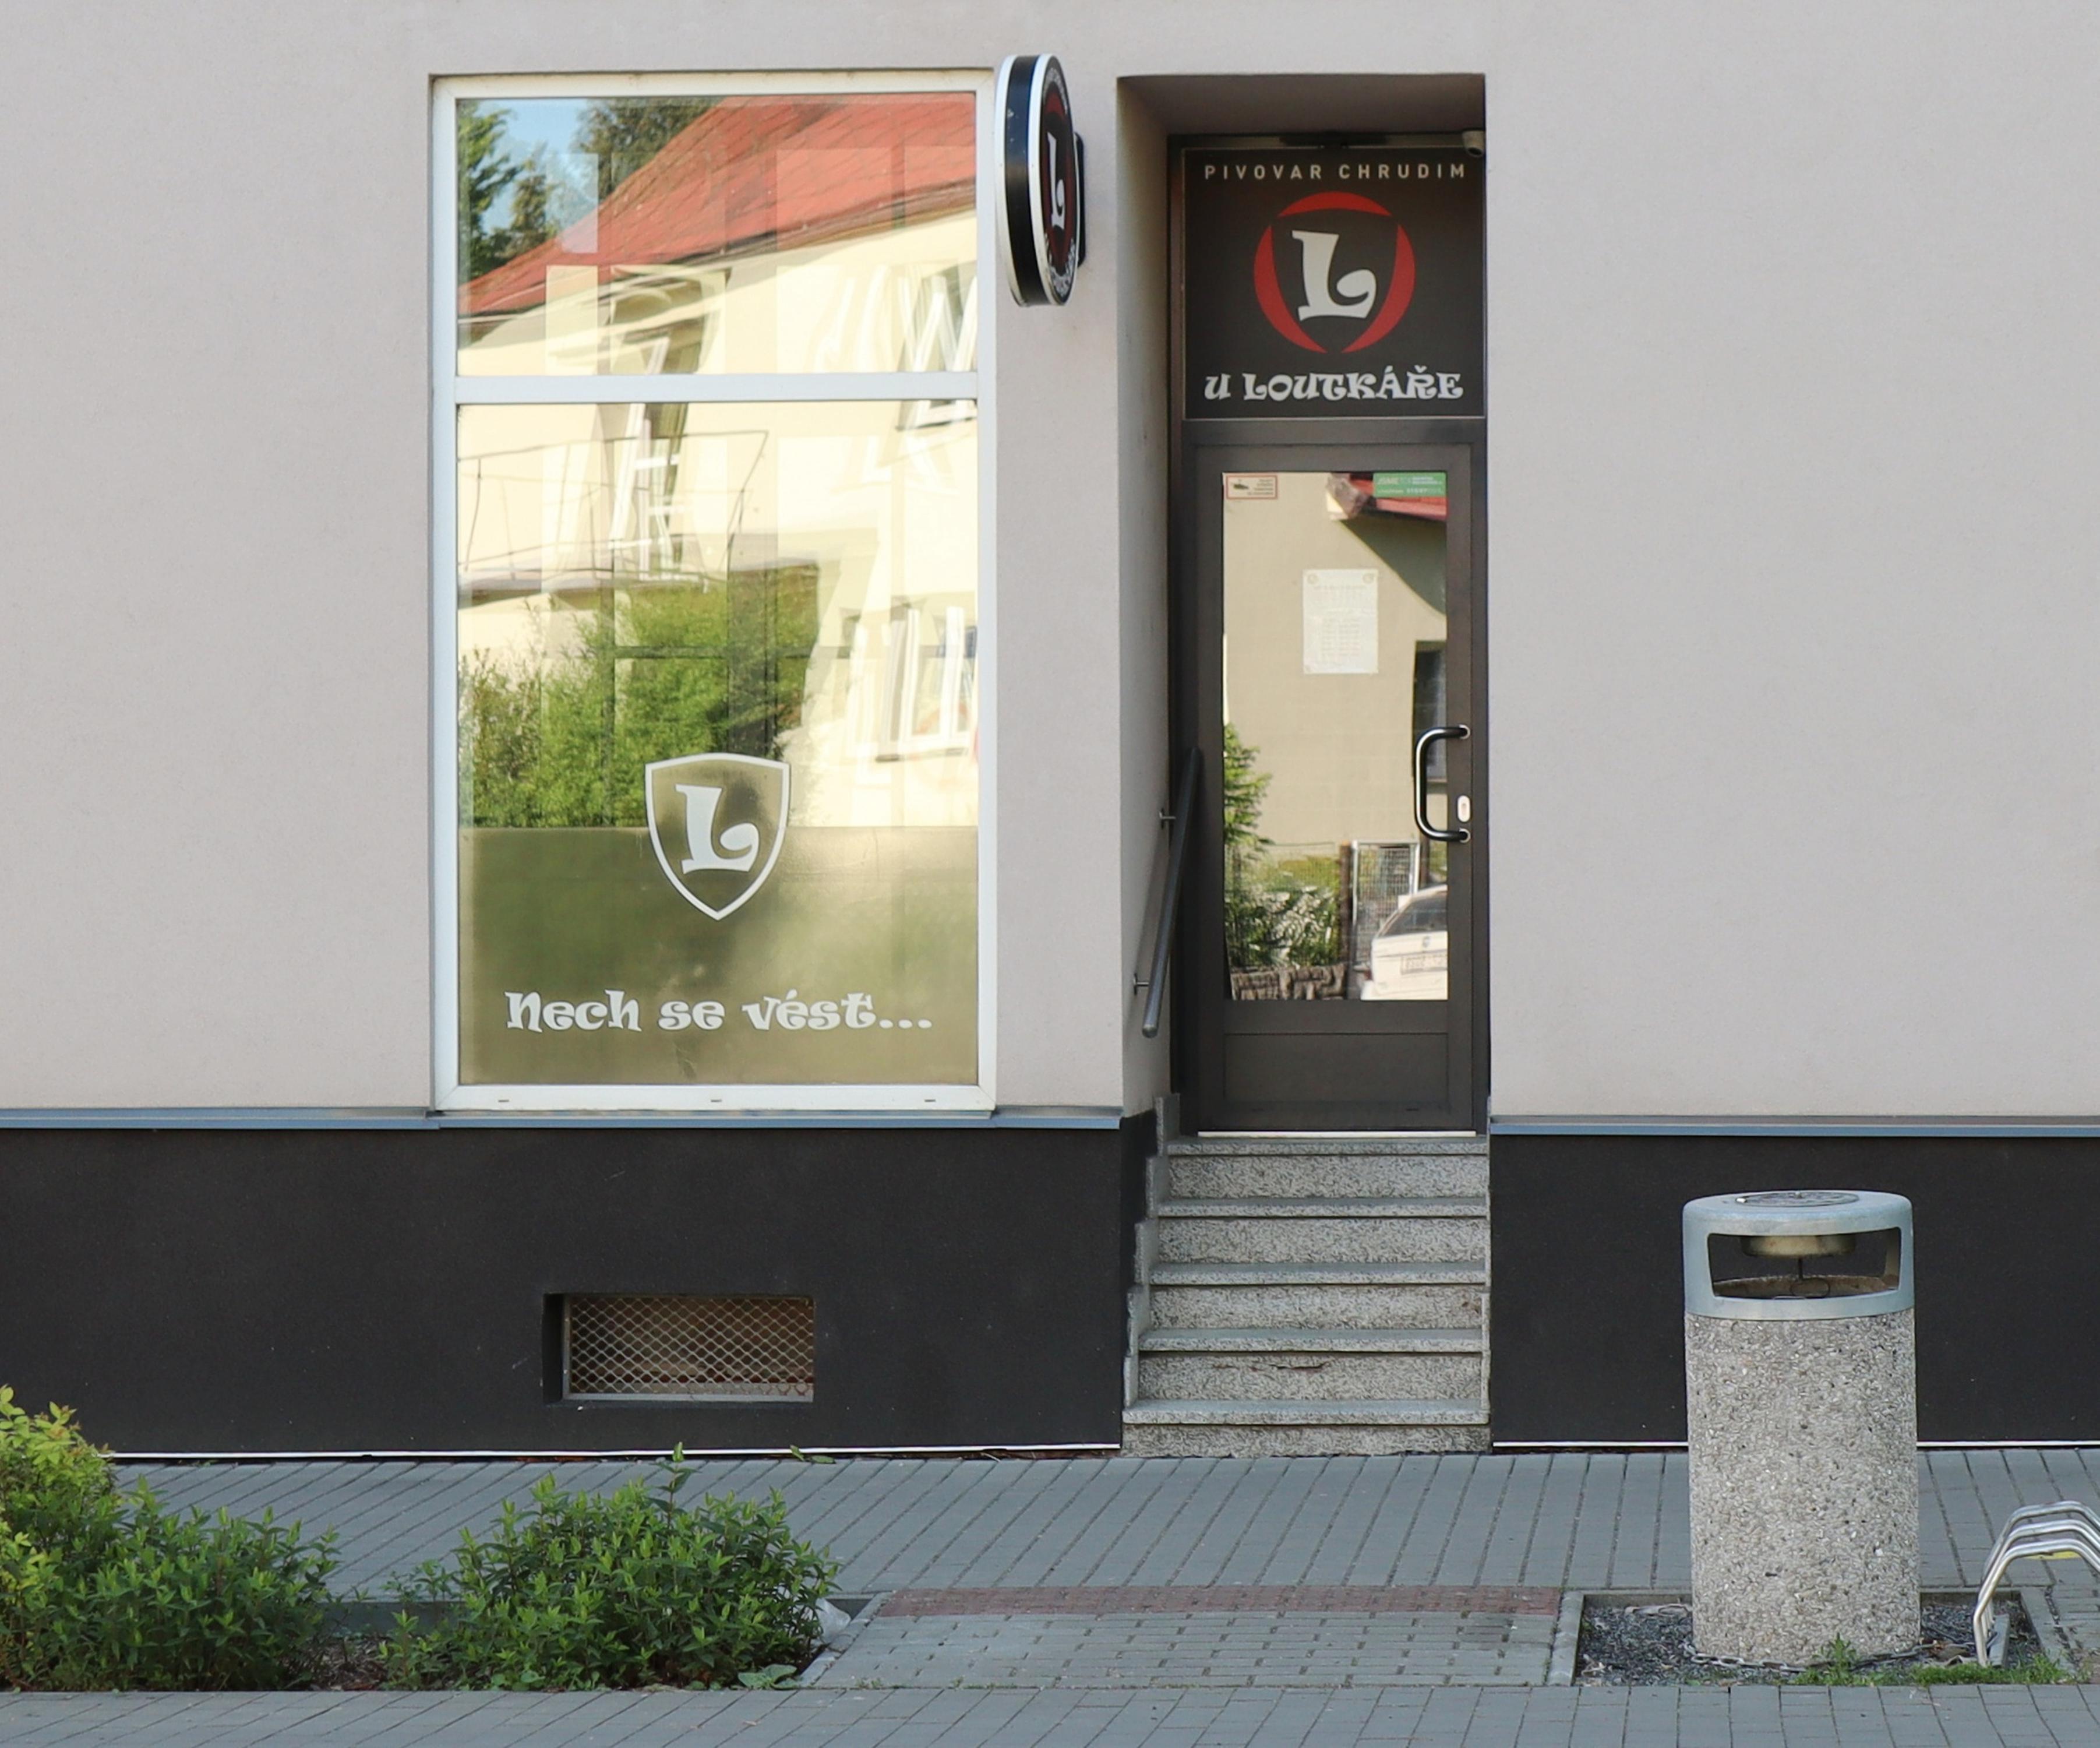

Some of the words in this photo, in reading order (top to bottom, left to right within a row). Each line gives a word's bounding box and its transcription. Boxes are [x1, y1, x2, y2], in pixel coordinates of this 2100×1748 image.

[1205, 164, 1322, 179] PIVOVAR
[1339, 164, 1464, 179] CHRUDIM
[1291, 230, 1377, 322] L
[1204, 373, 1231, 400] U
[1242, 365, 1464, 401] LOUTKÁŘE
[675, 783, 760, 874] L
[658, 1000, 725, 1031] se
[742, 988, 933, 1031] vést...
